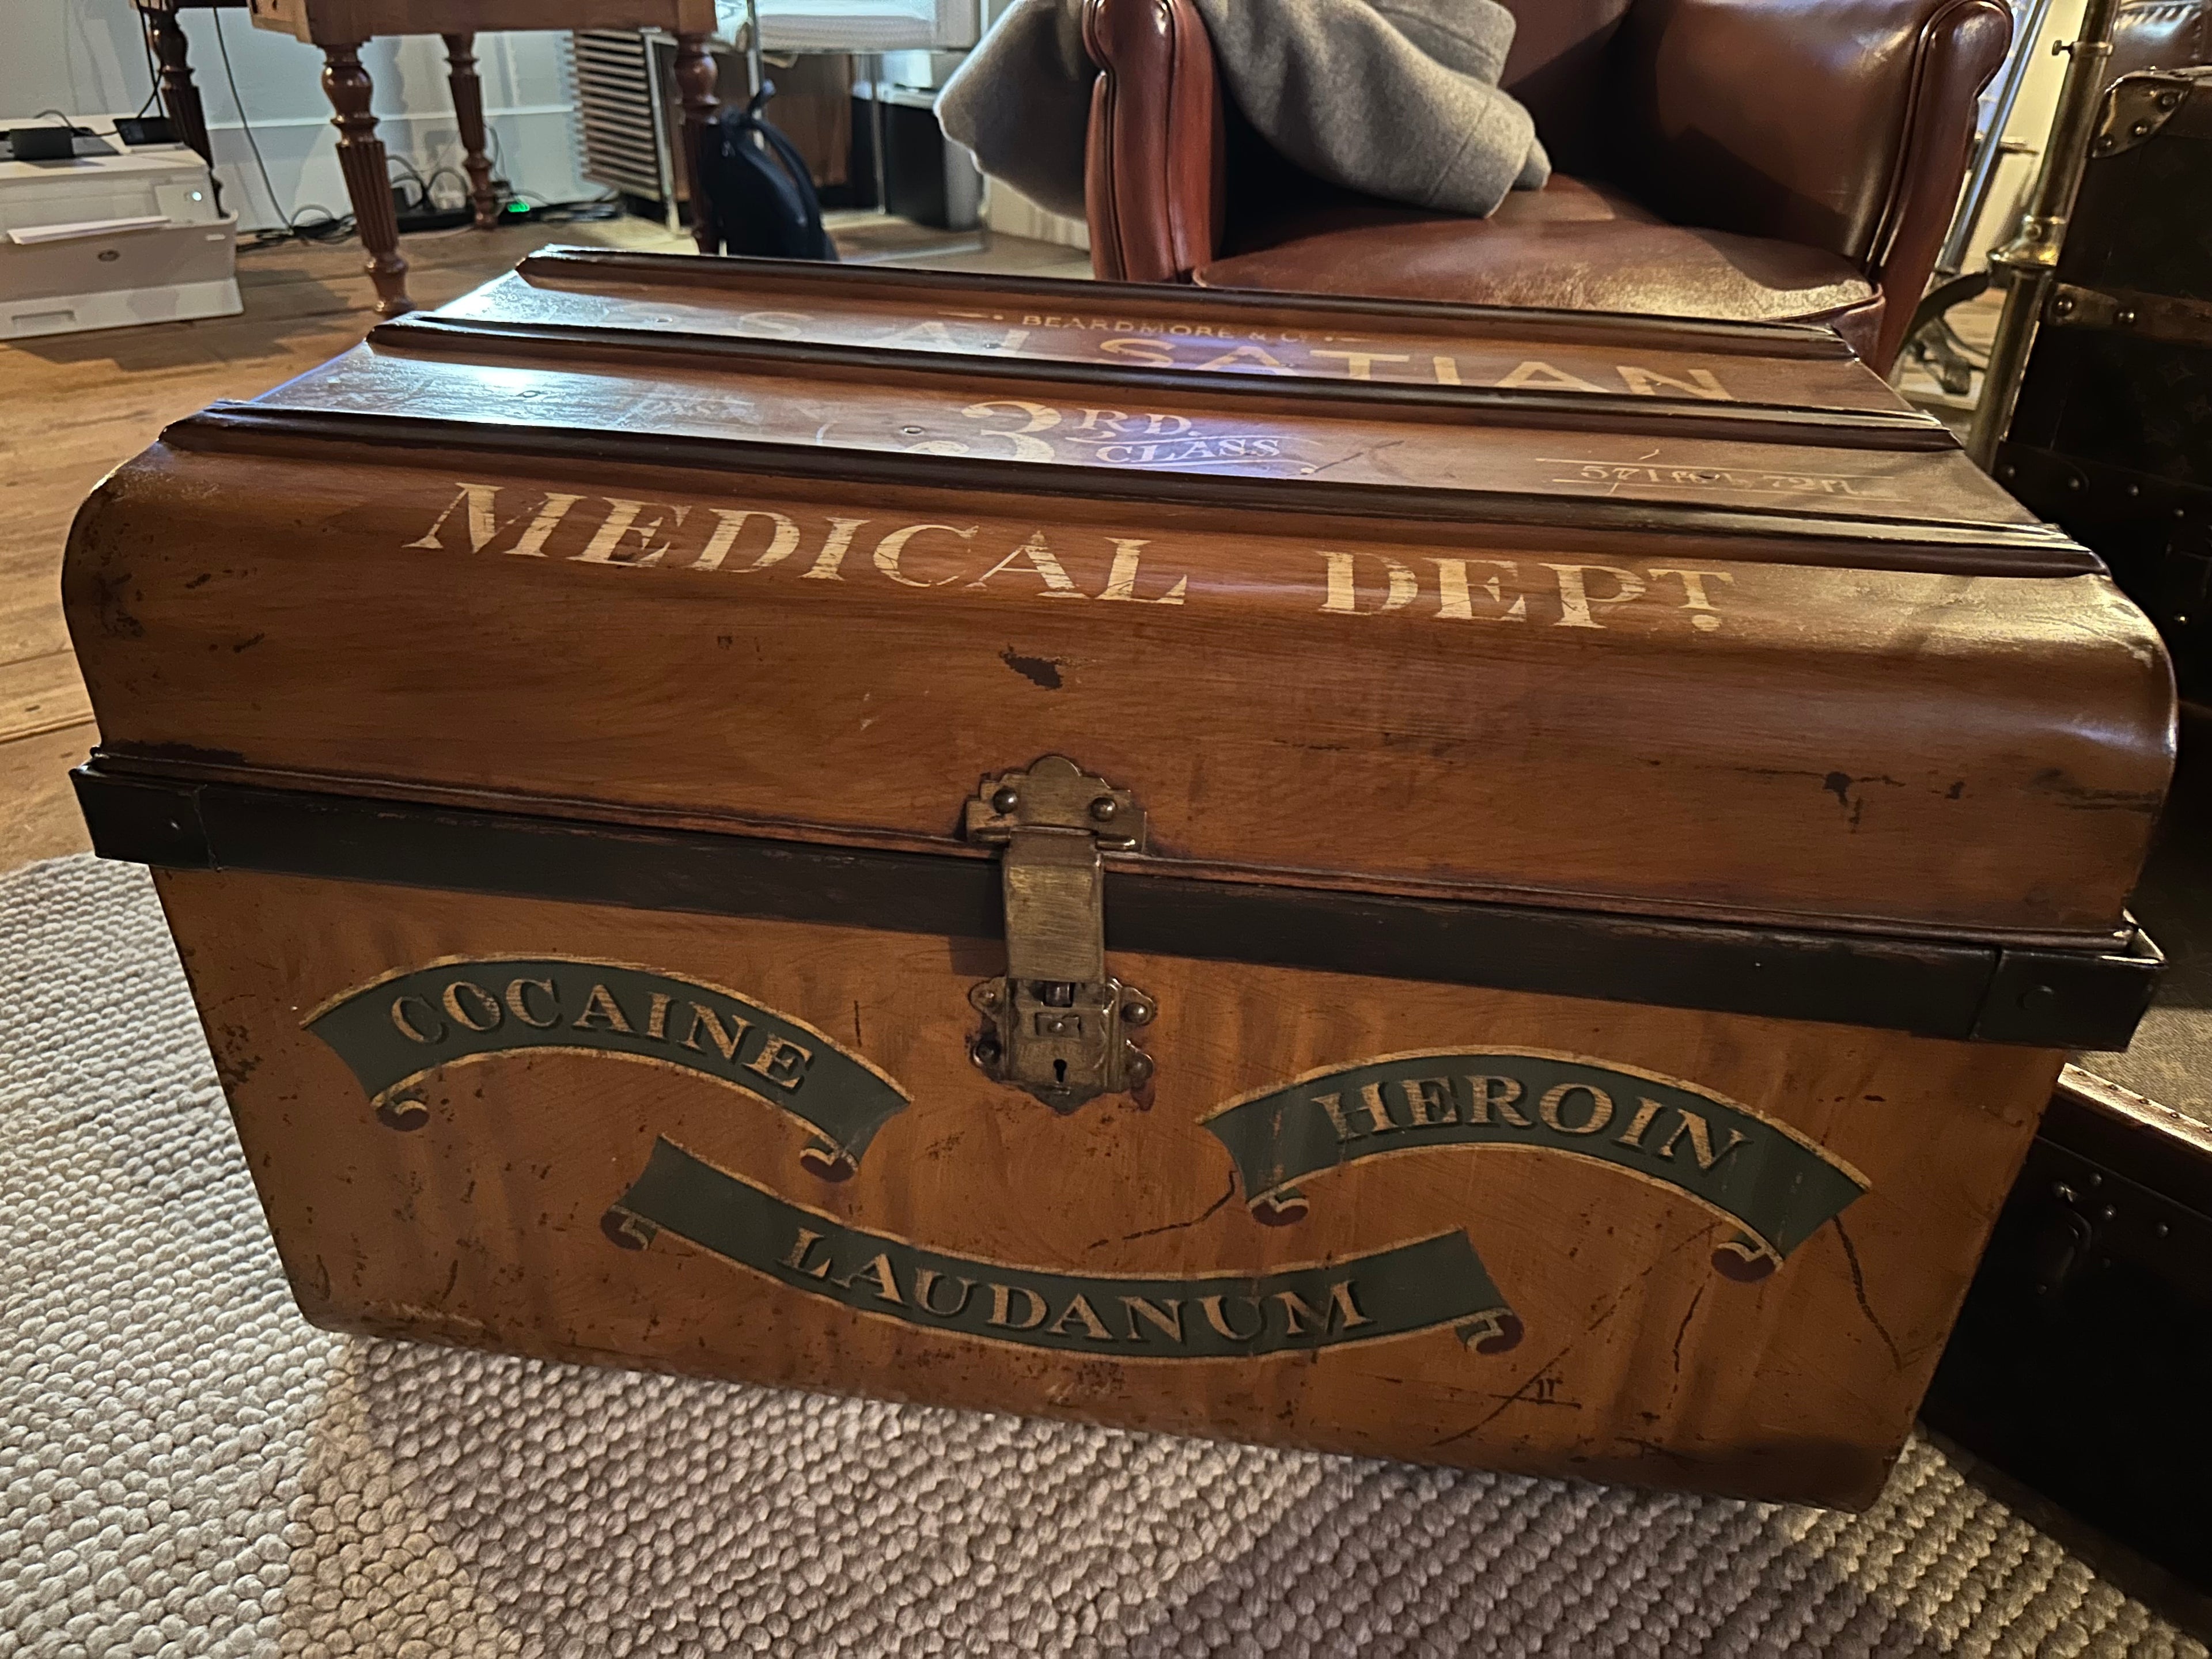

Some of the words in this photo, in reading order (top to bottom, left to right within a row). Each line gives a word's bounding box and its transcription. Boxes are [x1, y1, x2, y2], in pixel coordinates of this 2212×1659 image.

[1022, 315, 1234, 339] BEARDMORE
[1096, 439, 1281, 463] CLASS
[401, 482, 1188, 605] MEDICAL
[391, 978, 813, 1090] COCAINE
[1310, 1074, 1752, 1171] HEROIN
[779, 1227, 1374, 1343] LAUDANUM
